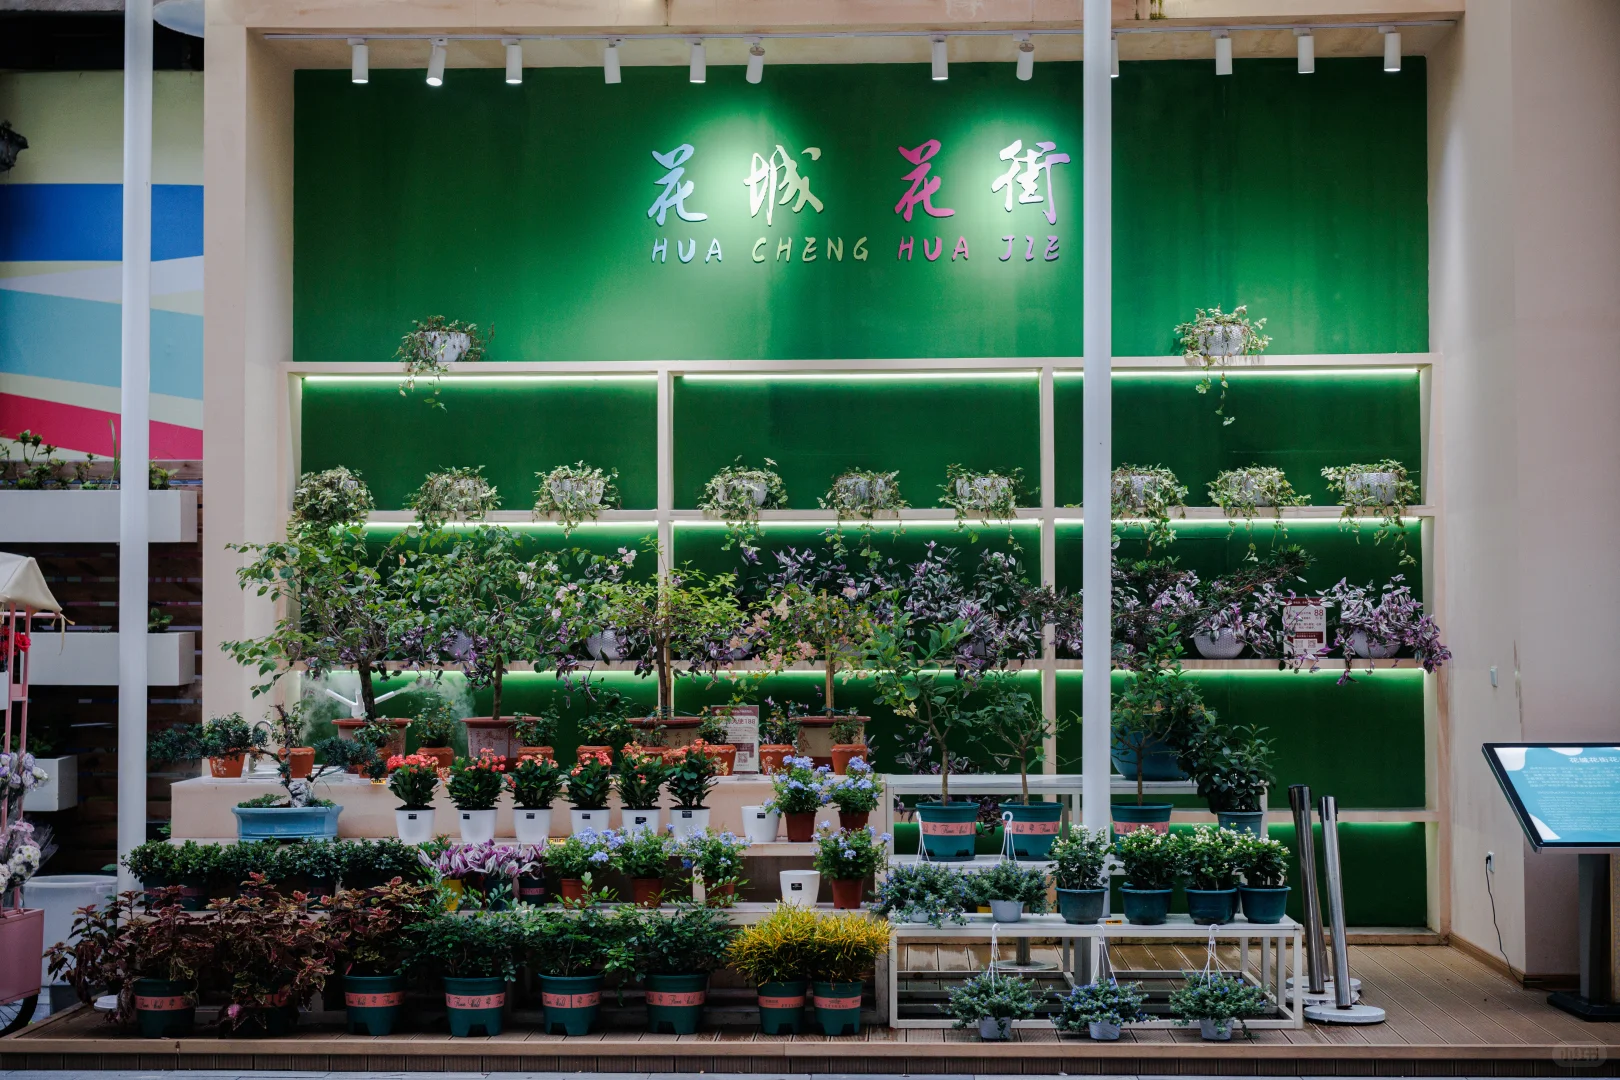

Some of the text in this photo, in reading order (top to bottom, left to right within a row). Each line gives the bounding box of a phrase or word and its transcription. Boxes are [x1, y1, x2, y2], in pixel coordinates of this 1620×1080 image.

[648, 139, 1070, 226] 花城 花街
[651, 237, 723, 262] HUA
[751, 236, 869, 262] CHENG
[898, 236, 969, 262] HUA
